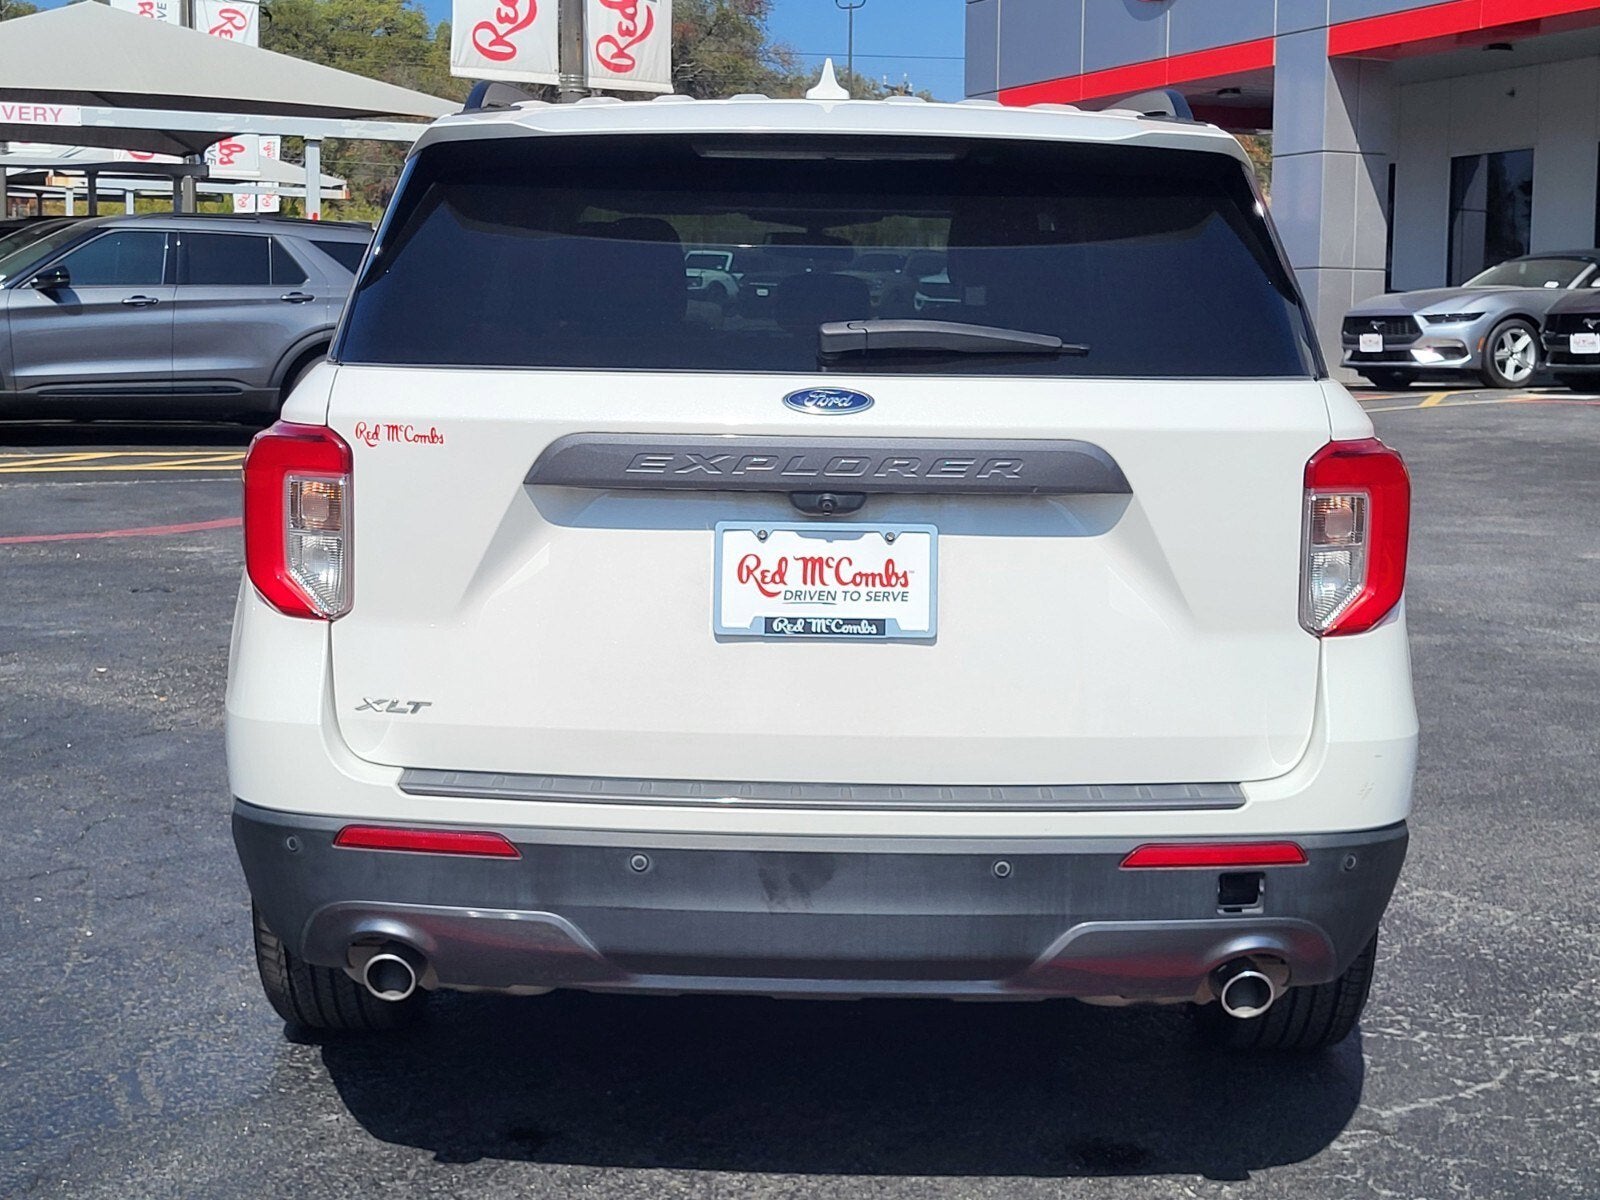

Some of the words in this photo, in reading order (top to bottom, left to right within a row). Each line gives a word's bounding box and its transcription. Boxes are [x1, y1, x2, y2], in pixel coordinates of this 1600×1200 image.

[208, 8, 247, 39] Re
[472, 0, 537, 61] Re
[803, 389, 854, 407] Ford
[355, 421, 380, 448] Red
[383, 424, 444, 445] McCombs
[625, 452, 1025, 479] EXPLORER
[737, 553, 788, 598] Red
[793, 556, 909, 588] McCombs
[783, 589, 837, 602] DRIVEN
[842, 590, 860, 602] TO
[865, 591, 909, 602] SERVE
[772, 617, 804, 635] Red
[806, 618, 878, 635] McCombs
[354, 697, 433, 714] XLT
